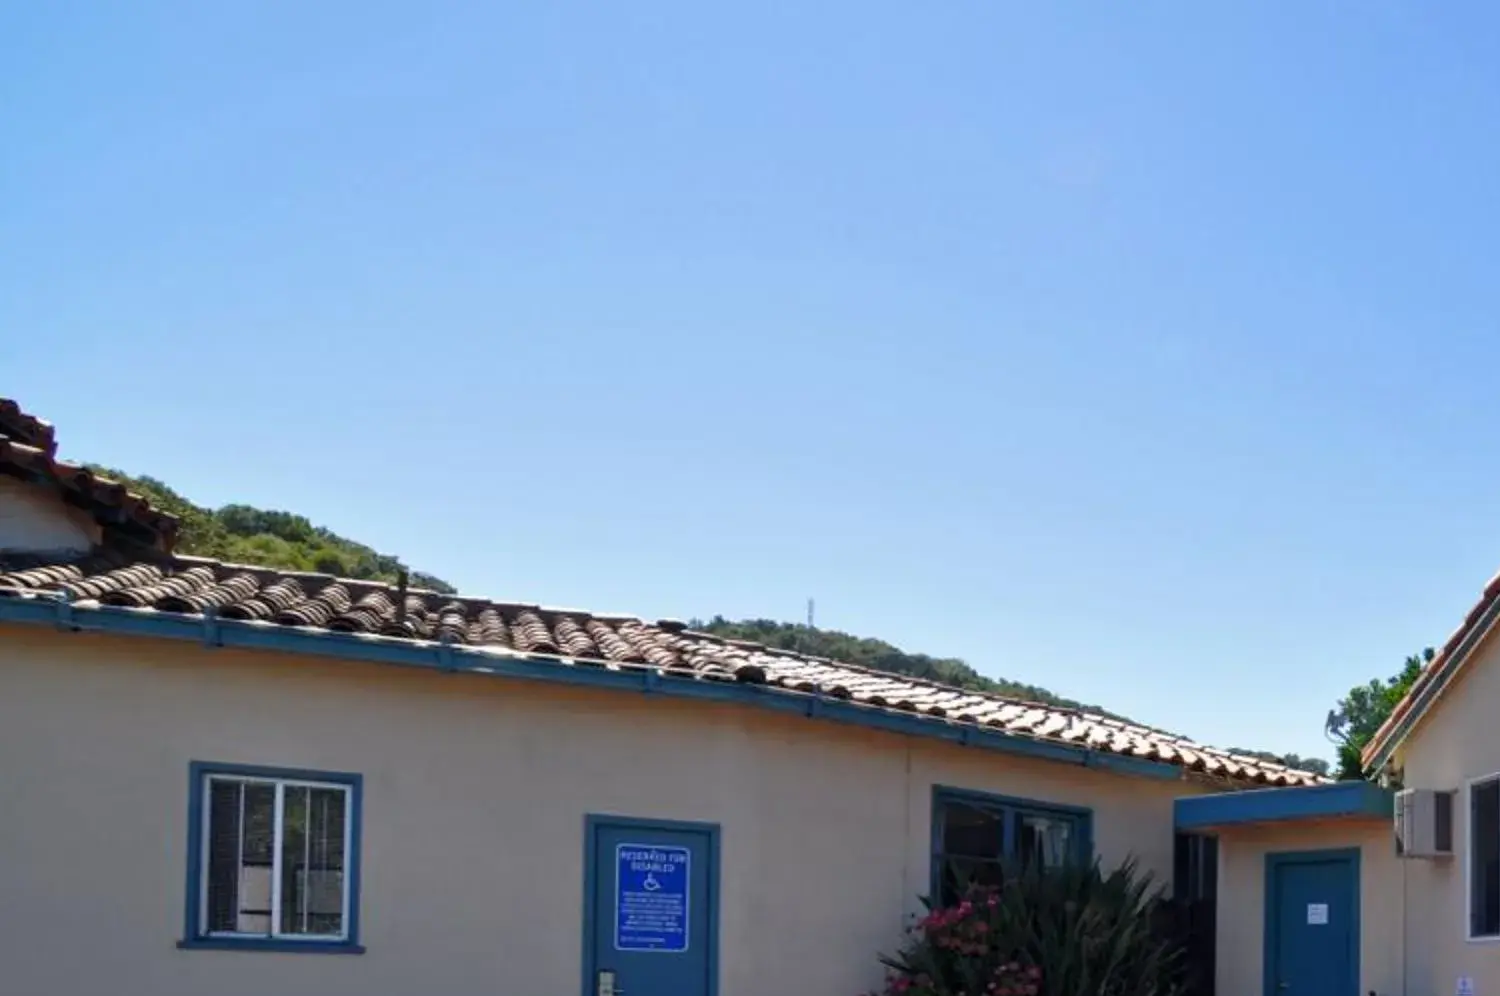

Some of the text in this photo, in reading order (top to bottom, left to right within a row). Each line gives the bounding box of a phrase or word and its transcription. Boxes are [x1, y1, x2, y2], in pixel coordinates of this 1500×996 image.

[622, 851, 685, 863] RESERVED FOR
[631, 862, 675, 872] DISABLED
